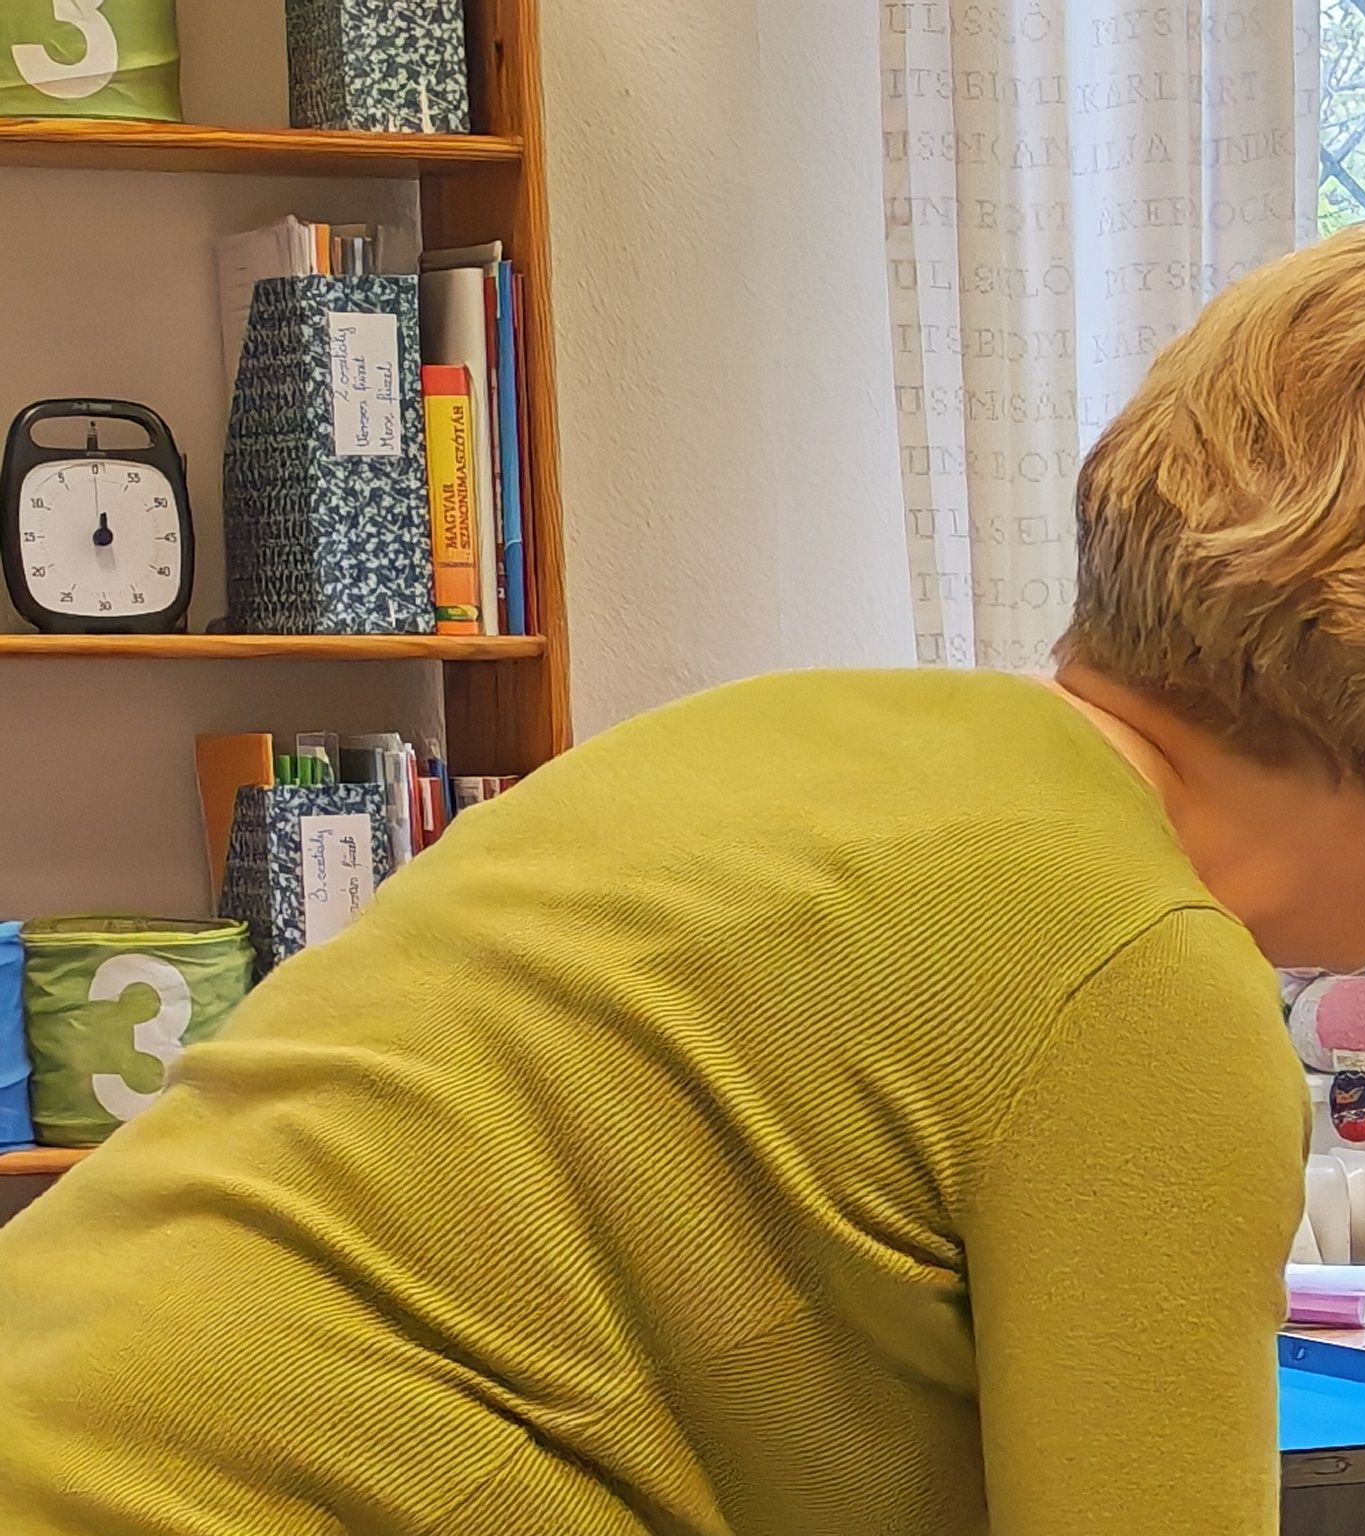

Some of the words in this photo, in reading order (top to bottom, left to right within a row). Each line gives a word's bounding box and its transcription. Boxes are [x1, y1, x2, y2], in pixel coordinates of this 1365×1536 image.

[31, 498, 44, 509] 10
[154, 498, 168, 509] 50
[443, 483, 457, 550] MAGYAR
[32, 566, 46, 578] 20
[157, 566, 171, 577] 40
[60, 592, 74, 603] 25
[131, 593, 145, 604] 35
[99, 601, 112, 612] 30
[88, 954, 192, 1122] 3
